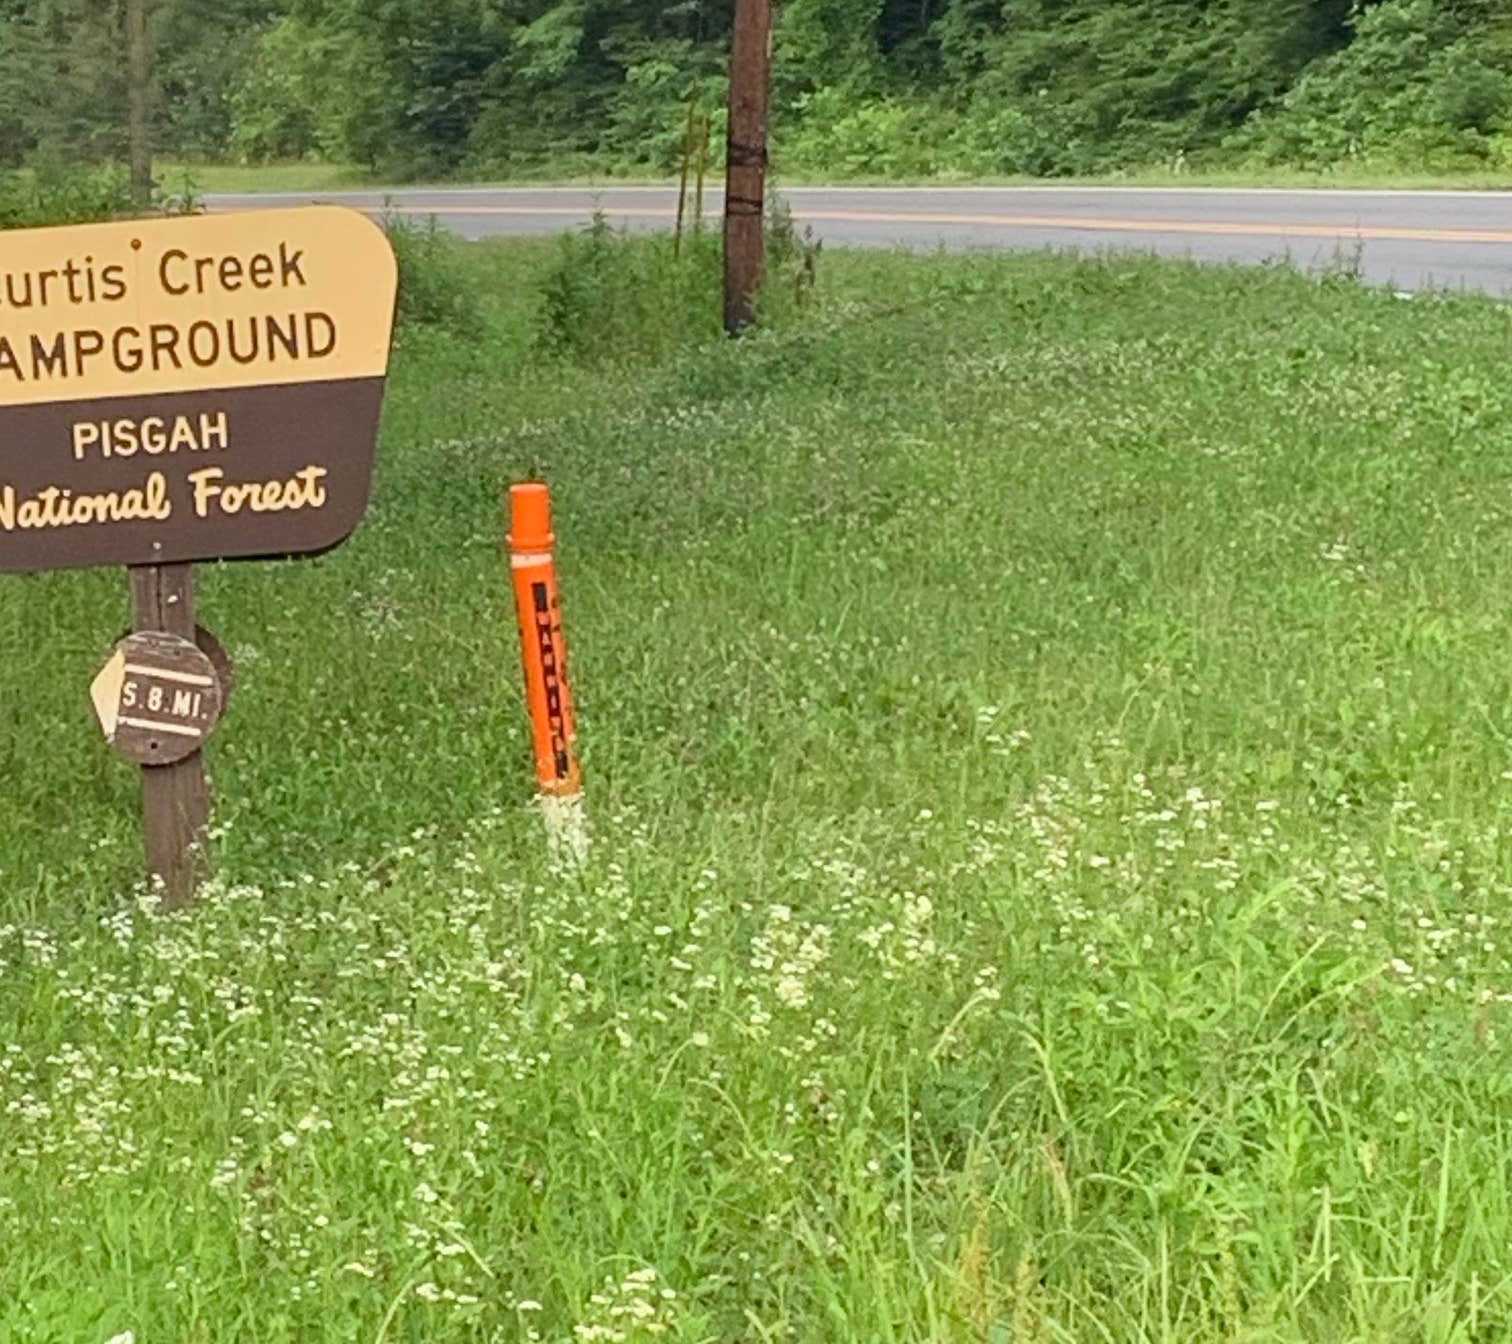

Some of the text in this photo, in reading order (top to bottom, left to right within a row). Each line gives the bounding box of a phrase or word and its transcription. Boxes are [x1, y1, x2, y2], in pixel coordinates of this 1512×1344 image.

[159, 242, 307, 296] Creek
[72, 412, 228, 460] PISGAH
[188, 465, 328, 518] Forest
